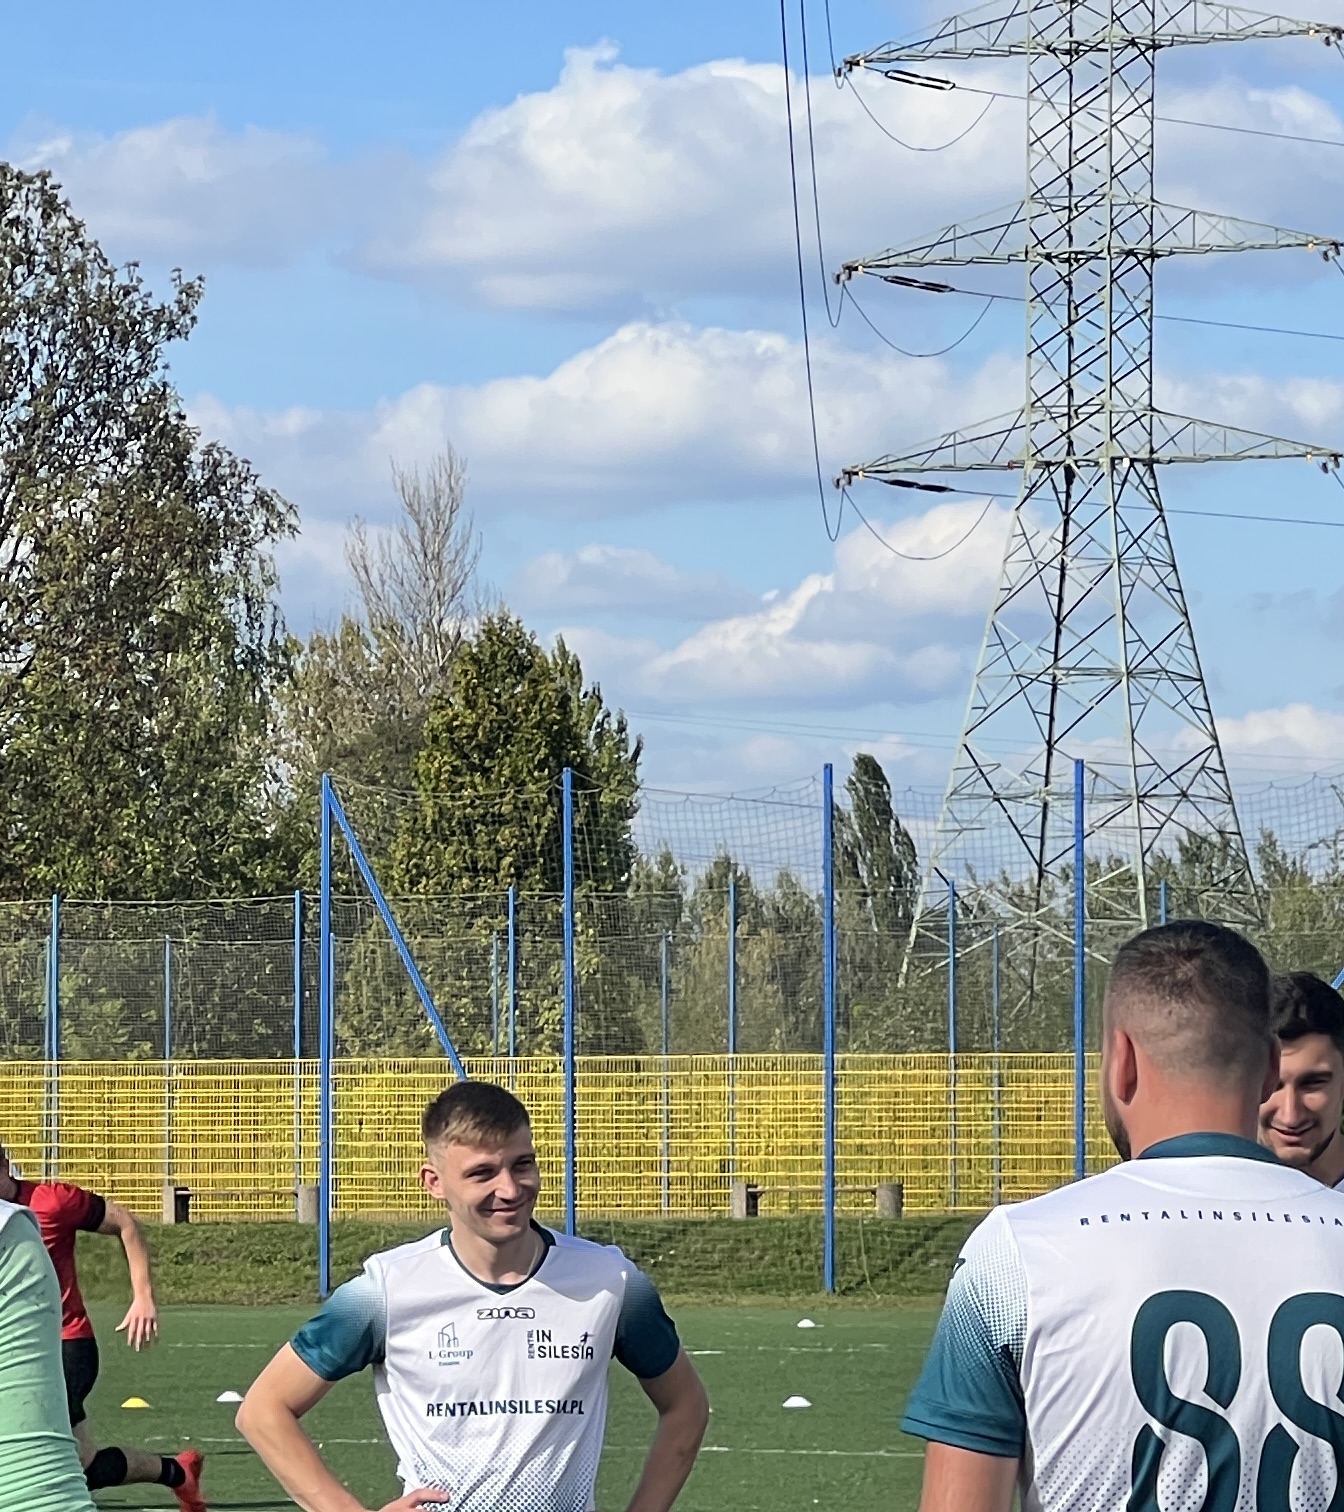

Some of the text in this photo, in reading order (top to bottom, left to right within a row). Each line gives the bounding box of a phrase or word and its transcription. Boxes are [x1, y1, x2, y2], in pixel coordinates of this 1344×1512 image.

[536, 1329, 552, 1342] IN
[439, 1349, 474, 1360] Group
[537, 1345, 594, 1360] SILESIA
